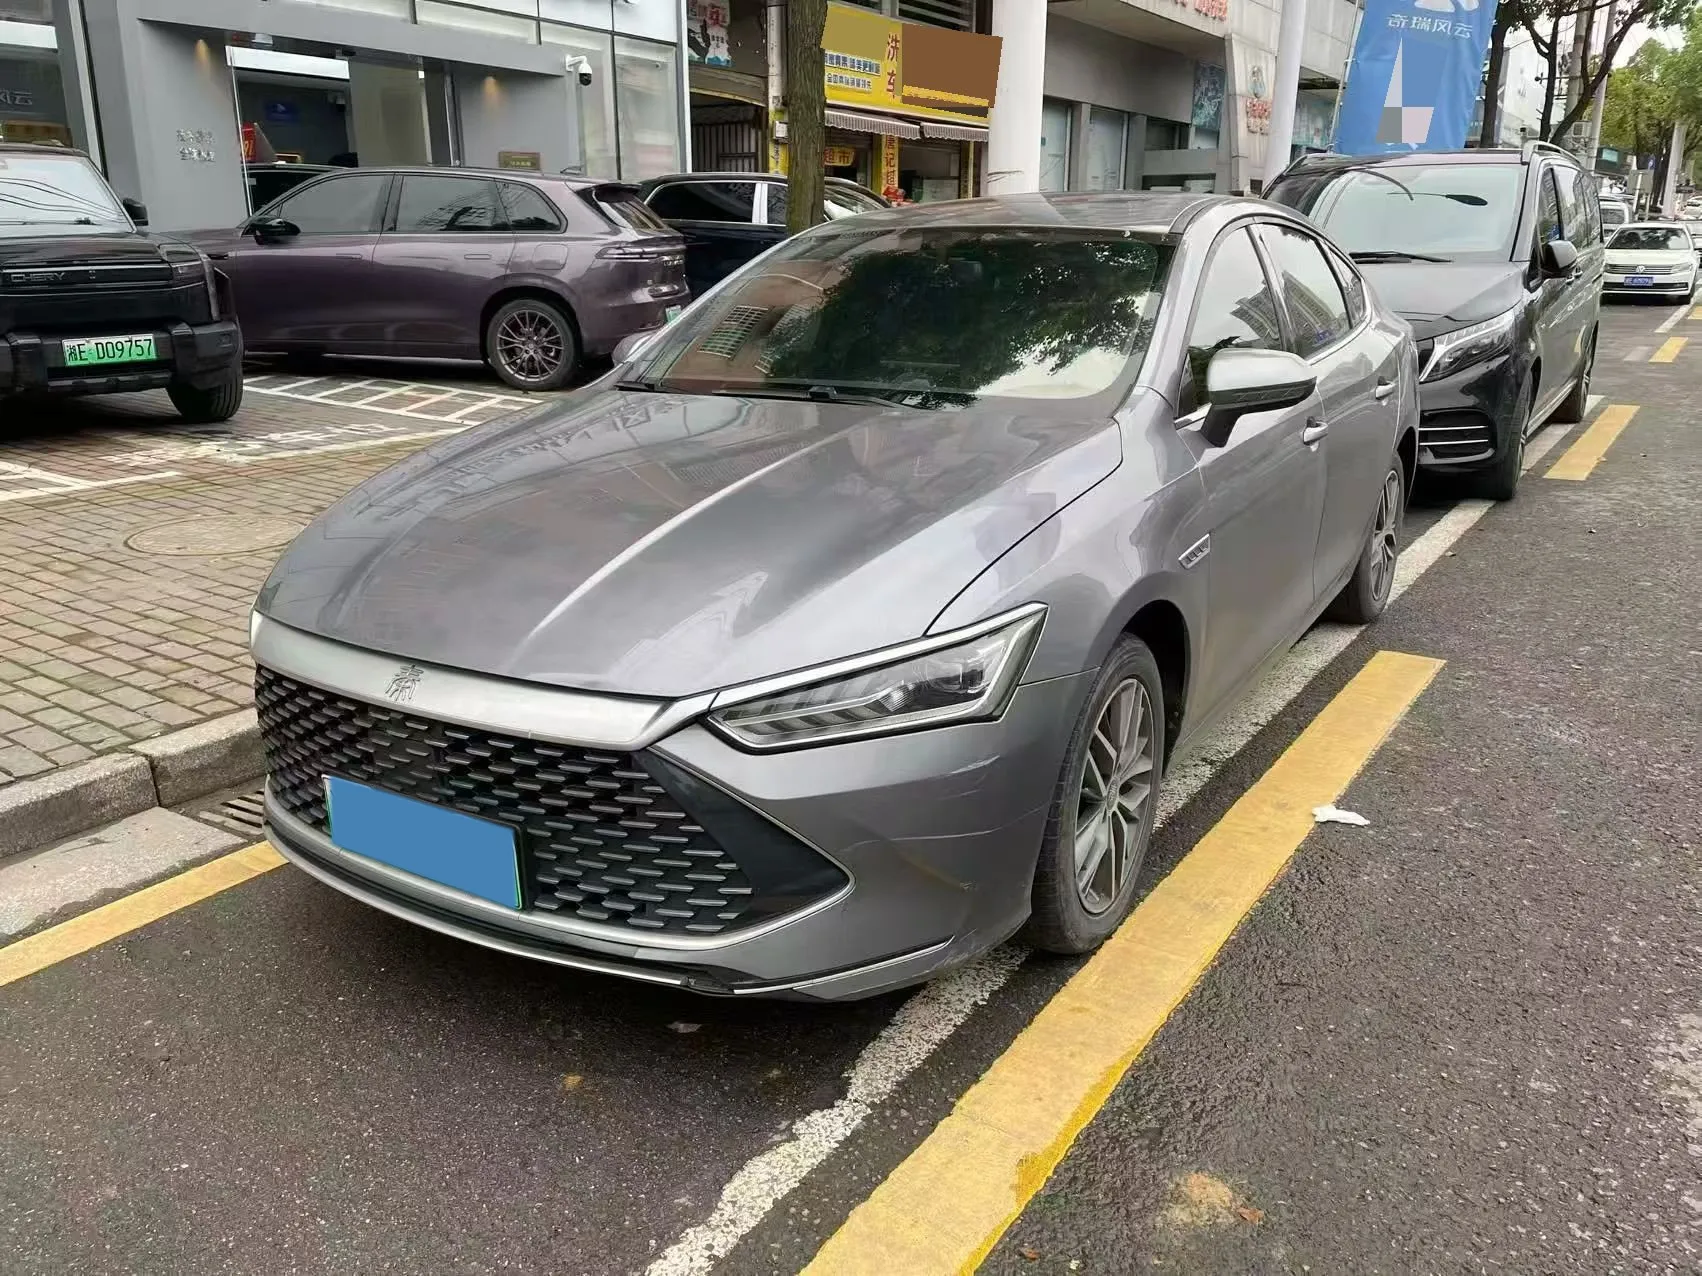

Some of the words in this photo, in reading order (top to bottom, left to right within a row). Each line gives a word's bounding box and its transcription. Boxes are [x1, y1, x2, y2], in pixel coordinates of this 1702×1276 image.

[1386, 13, 1474, 40] 奇瑞风云
[886, 32, 900, 100] 洗车
[10, 271, 66, 283] CHERY
[95, 338, 153, 361] D09757
